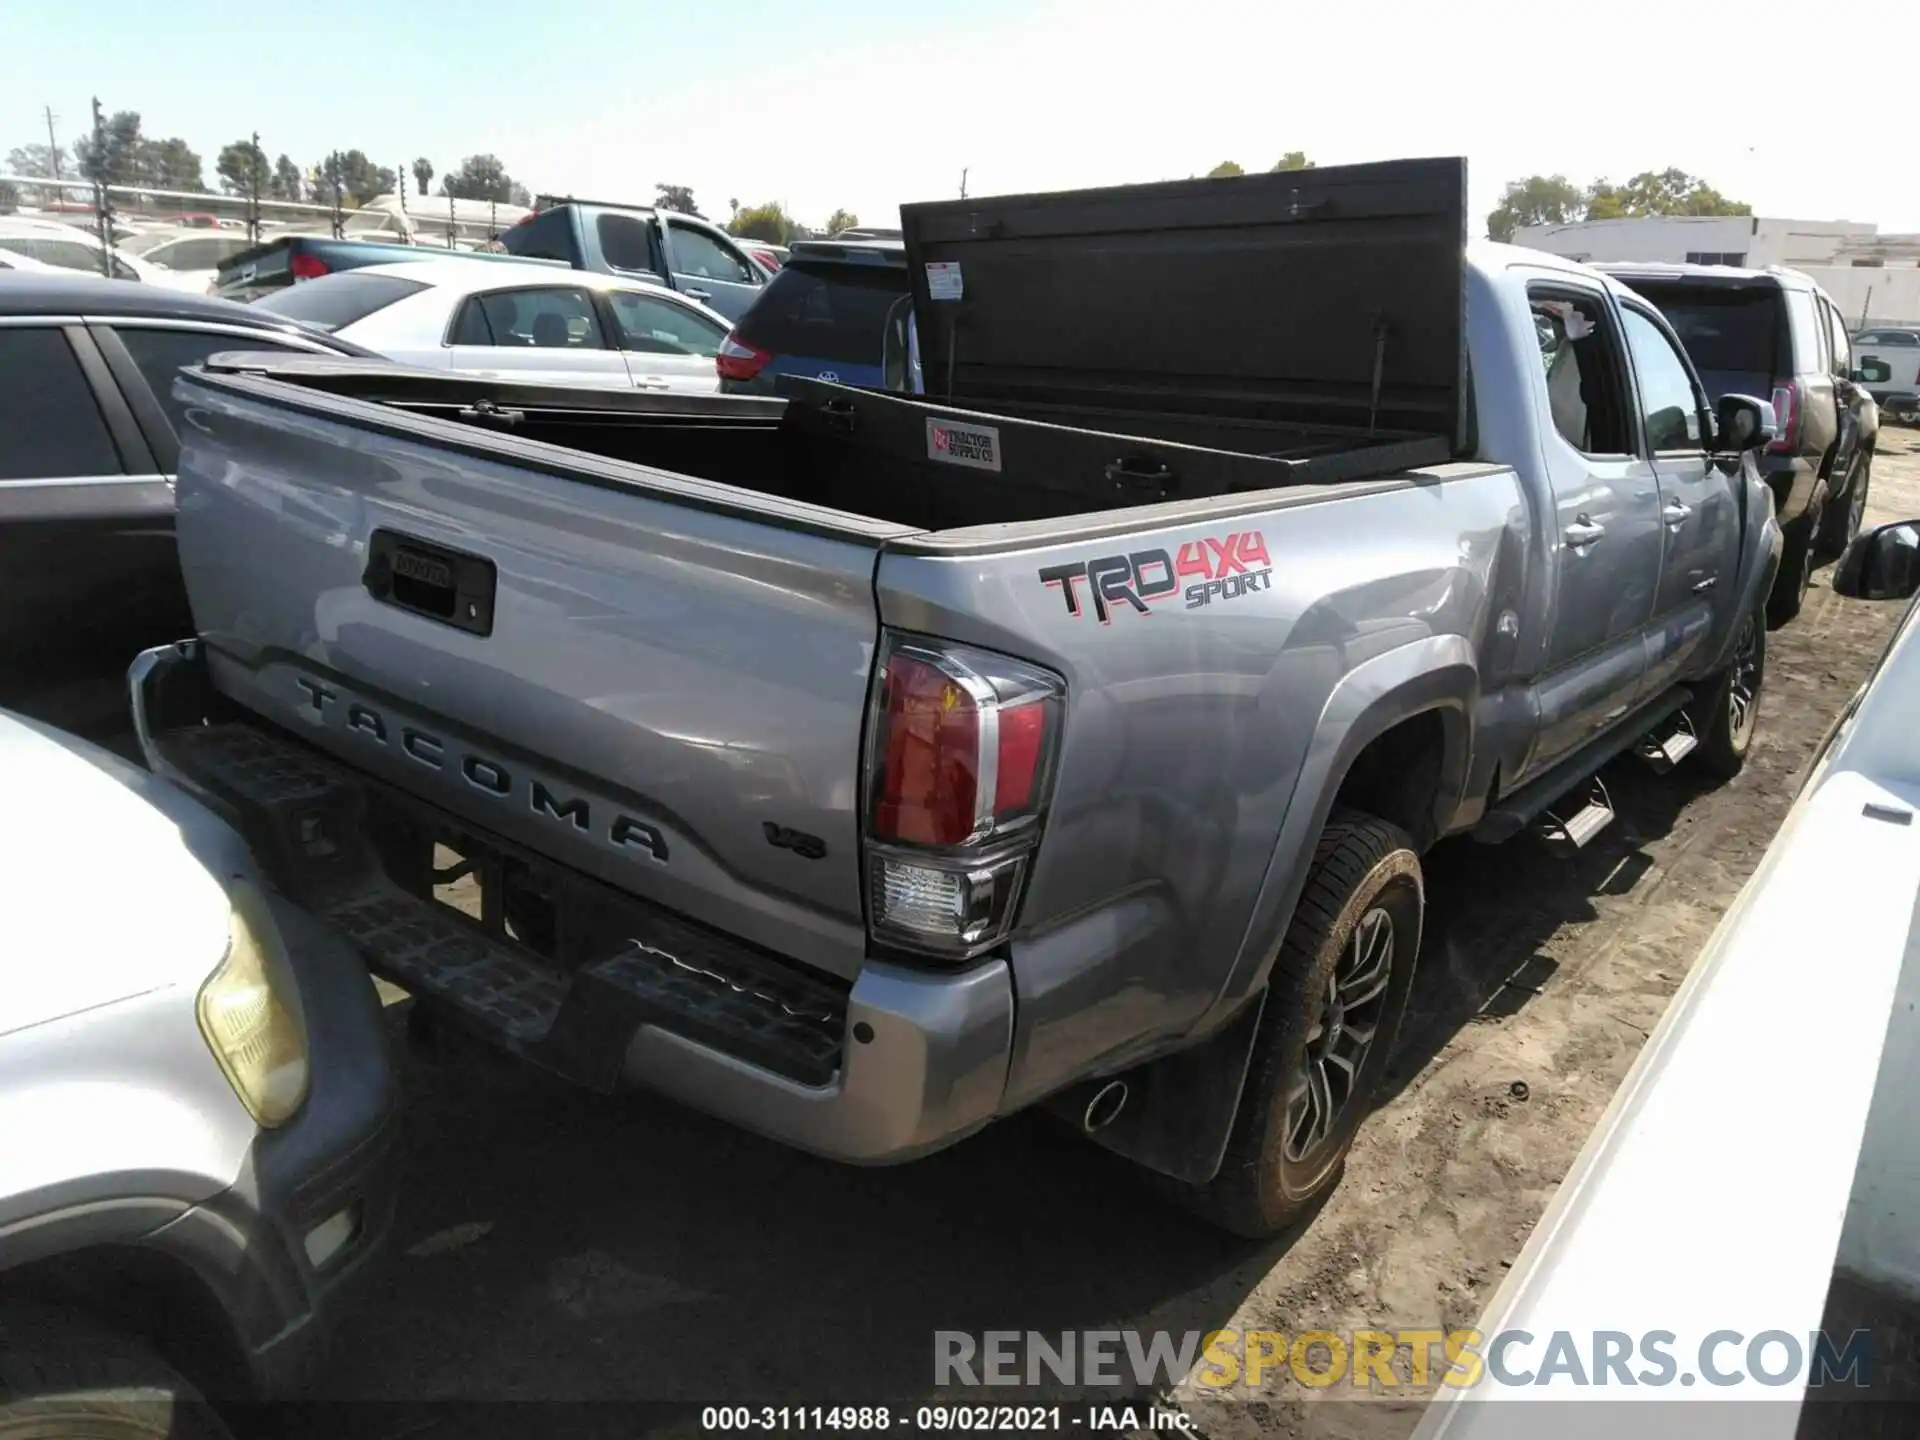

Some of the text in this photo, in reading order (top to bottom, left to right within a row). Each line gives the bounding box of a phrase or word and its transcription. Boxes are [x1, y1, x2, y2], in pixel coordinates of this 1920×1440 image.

[948, 429, 993, 449] TRACTOR
[948, 442, 981, 461] SUPPLY
[1038, 548, 1180, 626] TRD
[1184, 567, 1273, 610] SPORT
[296, 677, 669, 867] TACOMA
